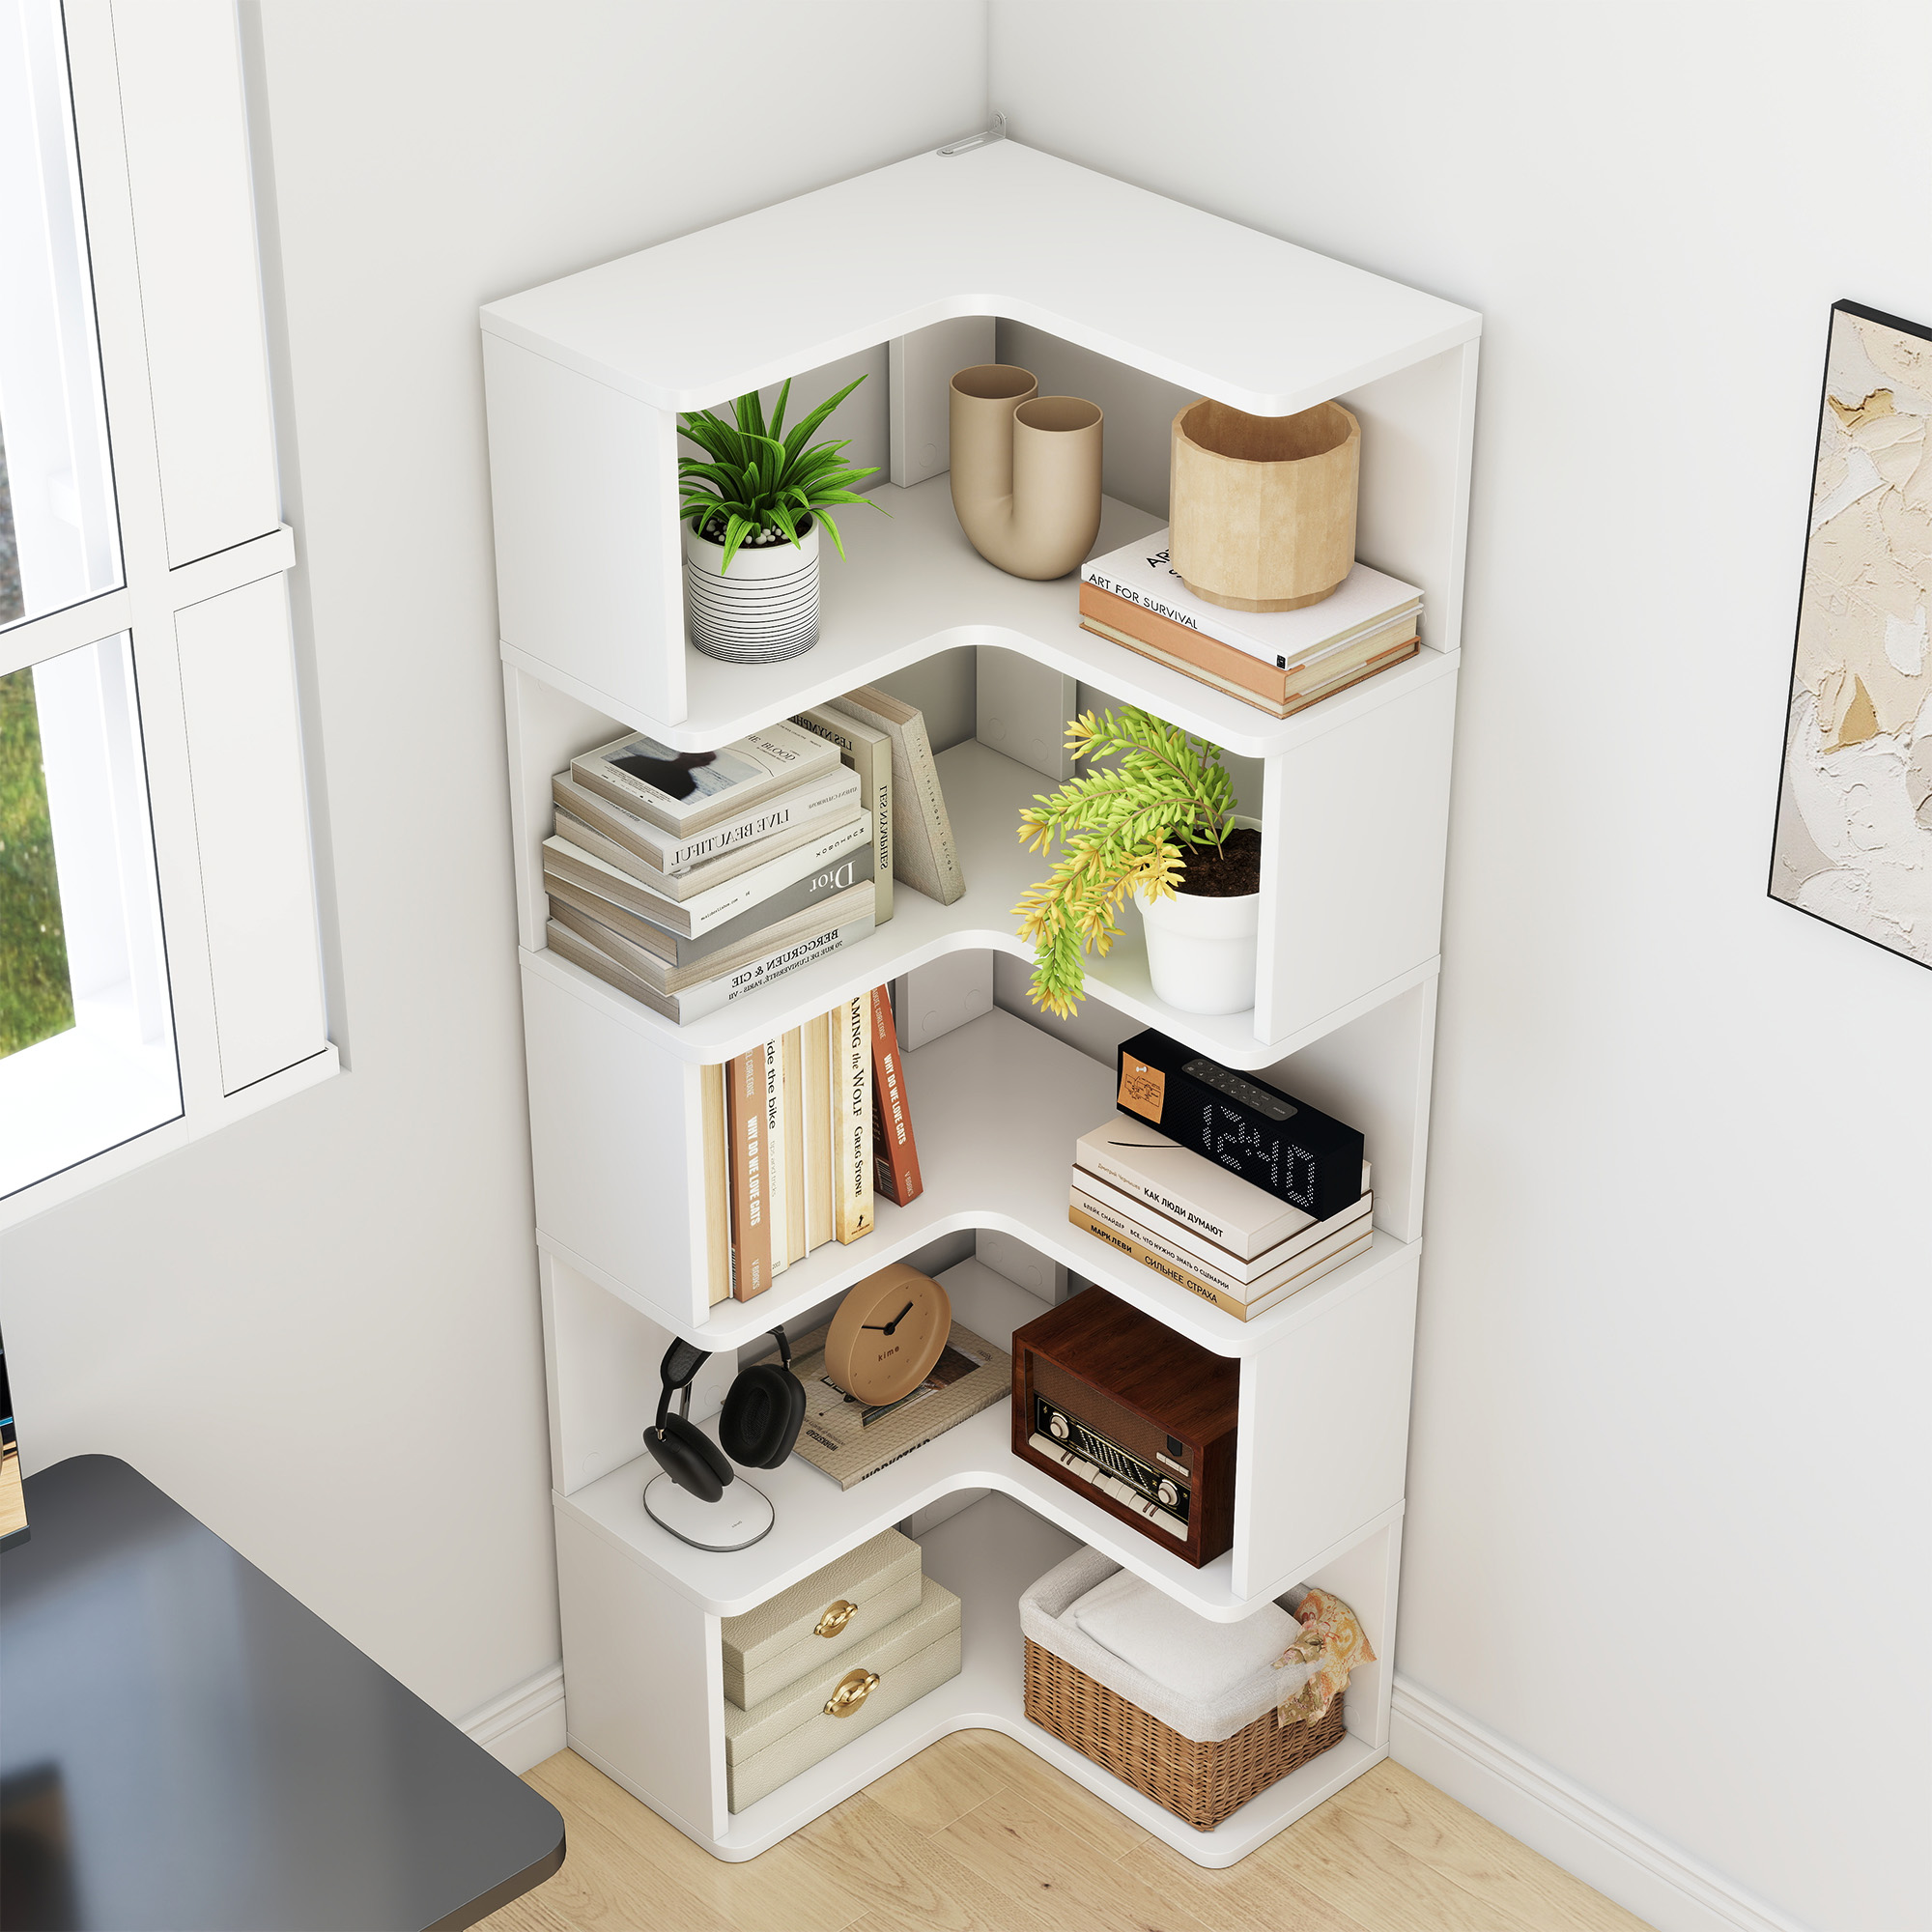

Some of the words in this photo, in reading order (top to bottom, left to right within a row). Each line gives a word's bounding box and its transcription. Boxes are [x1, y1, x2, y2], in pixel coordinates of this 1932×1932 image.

[1146, 549, 1170, 568] AR
[1089, 574, 1111, 589] ART
[1115, 584, 1139, 603] FOR
[1143, 597, 1198, 630] SURVIVAL
[761, 742, 796, 761] BLOOD
[810, 860, 856, 893] Dior
[852, 1052, 862, 1069] the
[883, 1053, 895, 1074] WHY
[767, 1068, 777, 1094] the
[852, 1068, 865, 1117] WOLF
[887, 1073, 896, 1088] DO
[890, 1086, 899, 1103] WE
[768, 1096, 778, 1129] bike
[892, 1100, 903, 1124] LOVE
[747, 1115, 758, 1140] WHY
[895, 1122, 907, 1146] CATS
[748, 1140, 758, 1157] DO
[854, 1126, 864, 1159] GREG
[749, 1156, 759, 1175] WE
[1202, 1104, 1316, 1208] 12:40
[749, 1174, 759, 1201] LOVE
[854, 1159, 864, 1198] STONE
[750, 1200, 761, 1227] CATS
[1083, 1203, 1100, 1216] БЛЕЙК
[1100, 1212, 1125, 1230] СНАЙДЕР
[1144, 1187, 1160, 1204] КАК
[1161, 1197, 1187, 1218] ЛЮДИ
[1187, 1212, 1224, 1238] ДУМАЮТ
[1091, 1225, 1112, 1241] МАРК
[1111, 1236, 1132, 1254] ЛЕВИ
[1142, 1236, 1153, 1246] ЧТО
[1153, 1242, 1176, 1259] НУЖНО
[1176, 1255, 1193, 1269] ЗНАТЬ
[1199, 1268, 1230, 1290] СЦЕНАРИИ
[752, 1265, 761, 1291] BOOKS
[1144, 1255, 1184, 1285] СИЛЬНЕЕ
[1186, 1279, 1218, 1304] СТРАХА
[878, 1346, 900, 1362] kime
[806, 1430, 838, 1451] WORKSTEAD
